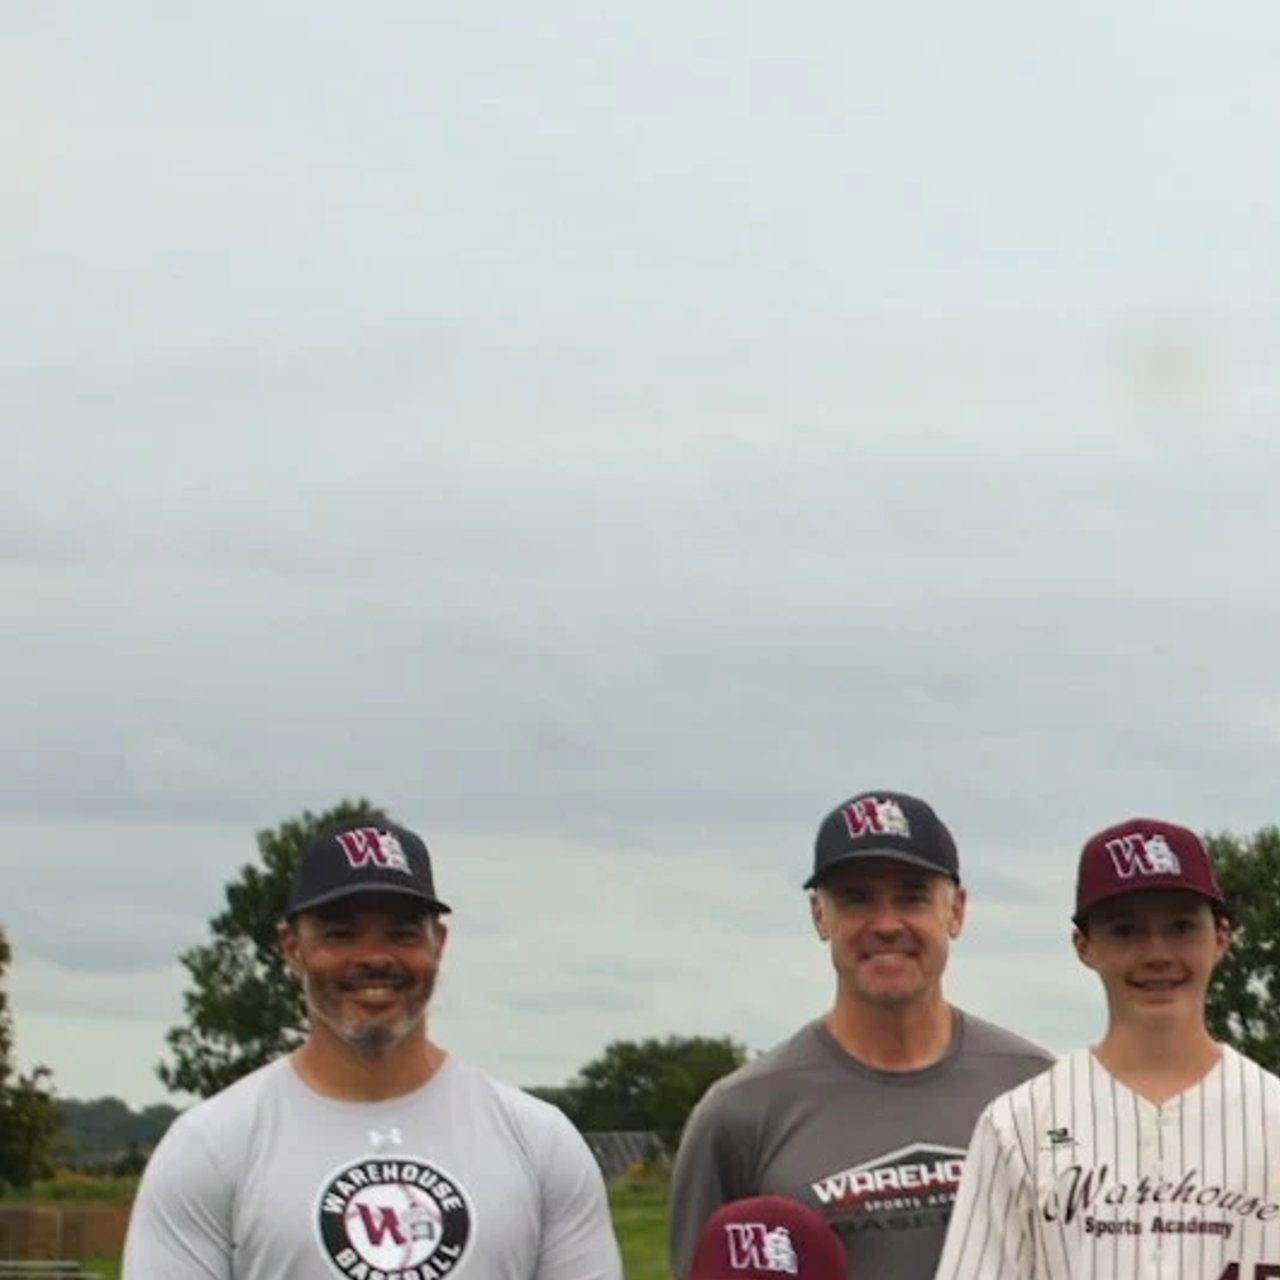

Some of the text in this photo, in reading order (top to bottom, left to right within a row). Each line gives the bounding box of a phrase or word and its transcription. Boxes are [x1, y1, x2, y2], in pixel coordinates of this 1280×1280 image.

[323, 1163, 464, 1214] WAREHOUSE
[865, 1194, 921, 1212] SPORTS
[1043, 1165, 1280, 1226] Warehouse
[1085, 1216, 1234, 1240] Sports Academy
